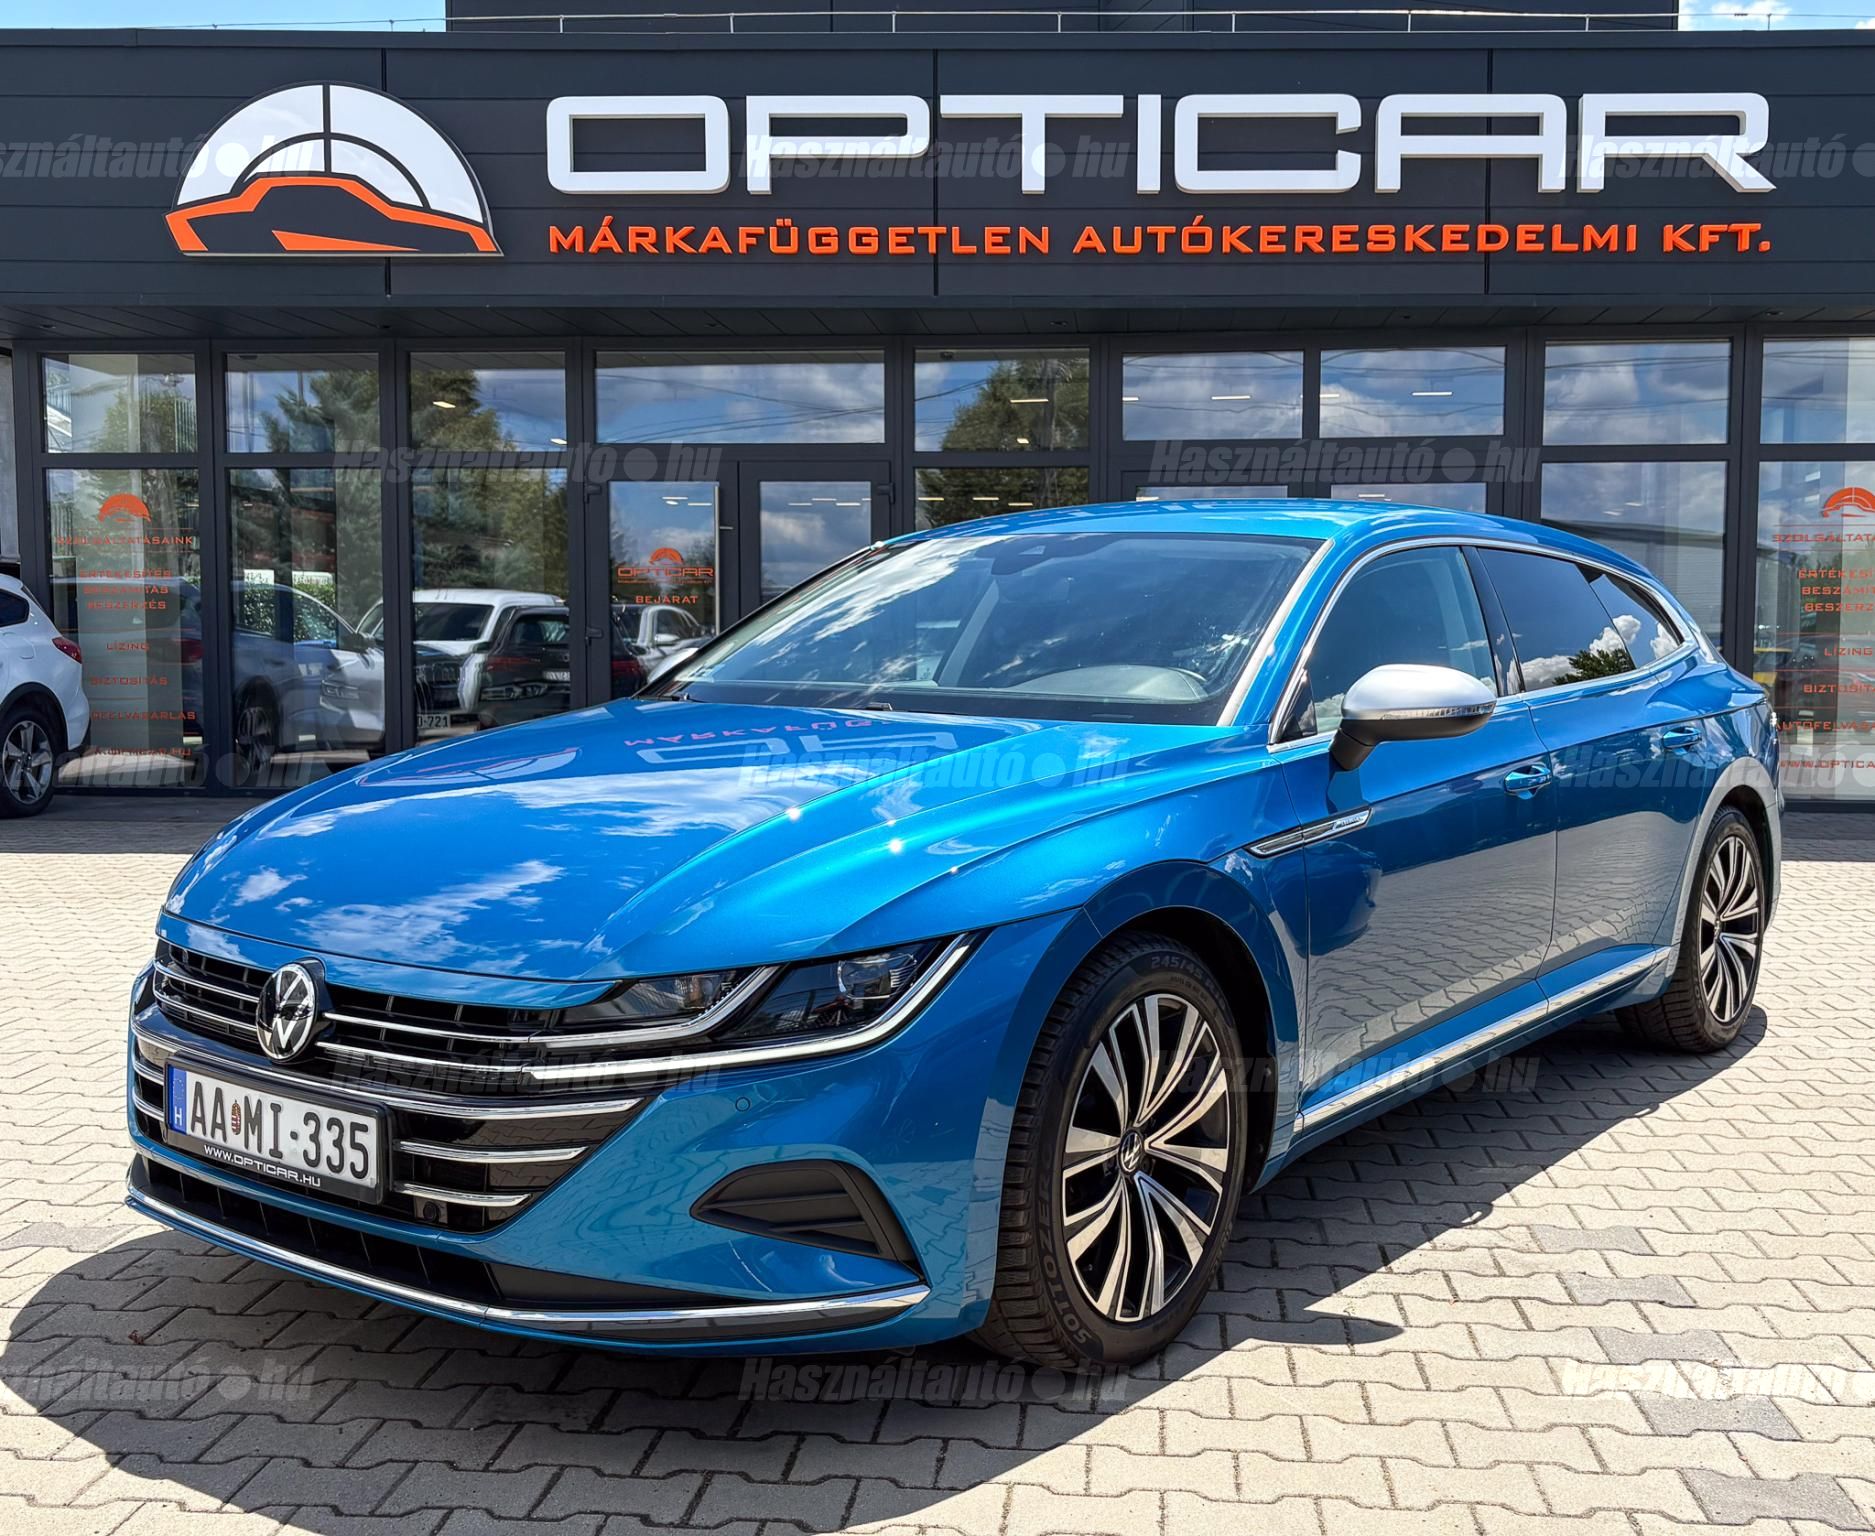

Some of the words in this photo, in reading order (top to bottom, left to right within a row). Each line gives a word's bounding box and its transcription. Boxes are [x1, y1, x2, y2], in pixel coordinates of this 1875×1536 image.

[546, 93, 1776, 194] OPTICAR
[549, 216, 1049, 254] MÁRKAFÜGGETLEN
[1073, 215, 1637, 254] AUTÓKERESKEDELMI
[1663, 222, 1771, 253] KFT.
[617, 567, 714, 577] OPTICAR
[204, 1144, 321, 1188] WWW.OPTICAR.HU
